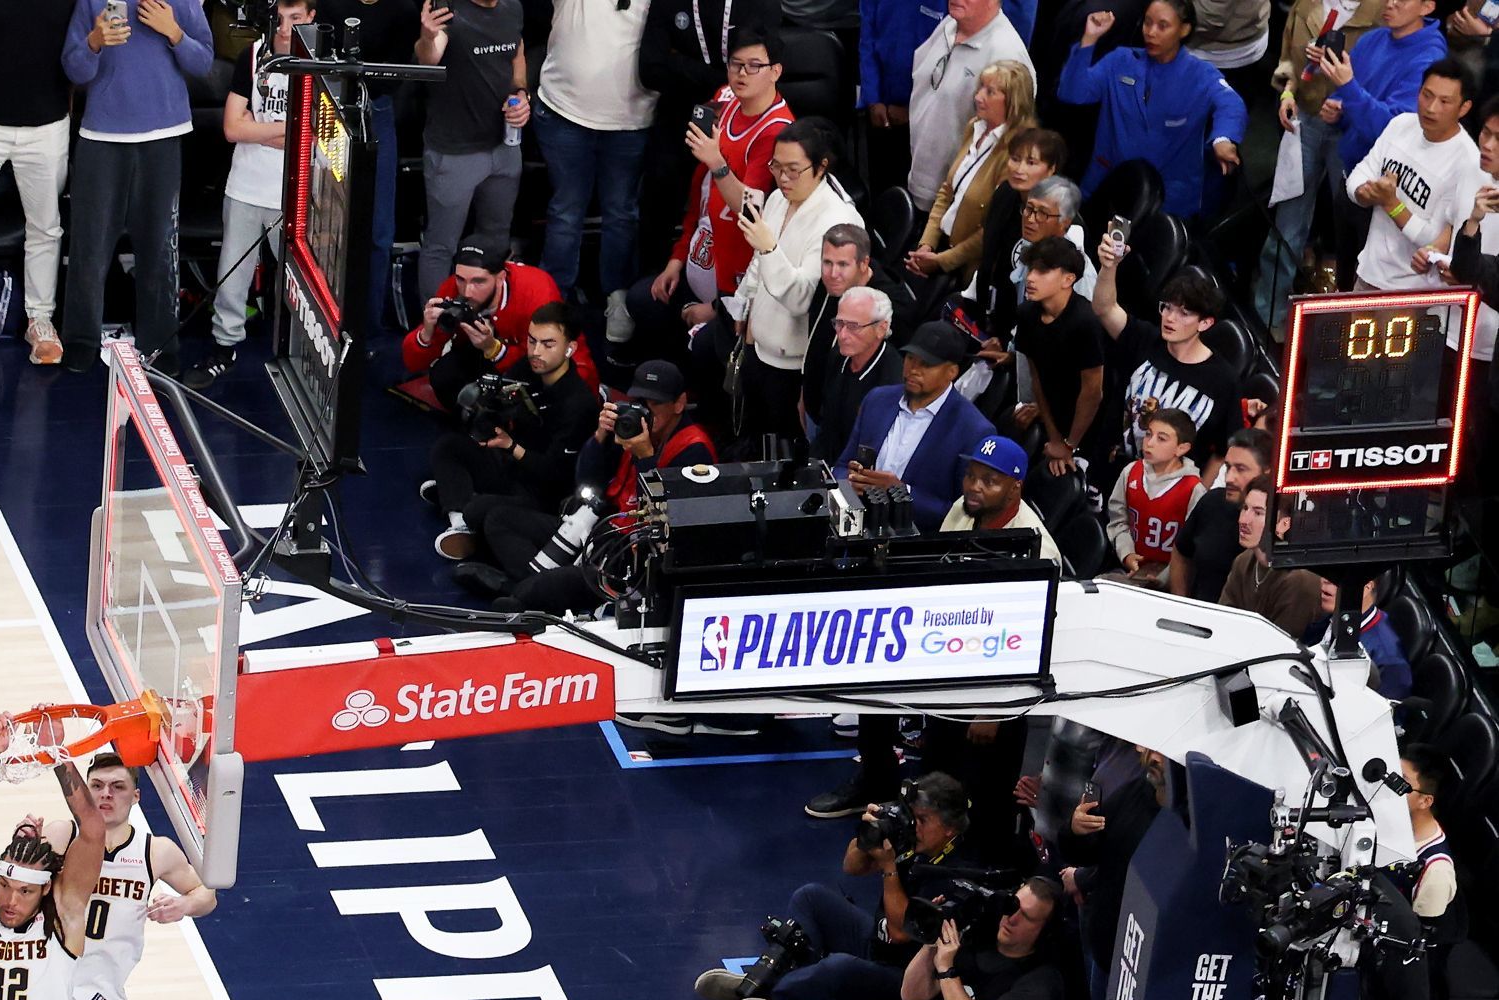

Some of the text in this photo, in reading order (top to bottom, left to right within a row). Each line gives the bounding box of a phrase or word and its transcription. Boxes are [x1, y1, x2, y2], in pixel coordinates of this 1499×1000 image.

[473, 43, 516, 55] GIVENCHY
[1347, 316, 1414, 360] 0.0
[129, 366, 152, 395] Emirates
[158, 427, 181, 456] Emirates
[1334, 443, 1448, 468] TISSOT
[187, 489, 210, 519] Emirates
[1145, 517, 1179, 552] 32
[216, 551, 240, 581] Emirates
[924, 608, 994, 627] Presented by
[733, 606, 913, 670] PLAYOFFS
[921, 628, 1022, 658] Google
[91, 877, 145, 900] GGETS
[1124, 913, 1145, 974] GET
[1195, 954, 1233, 982] GET
